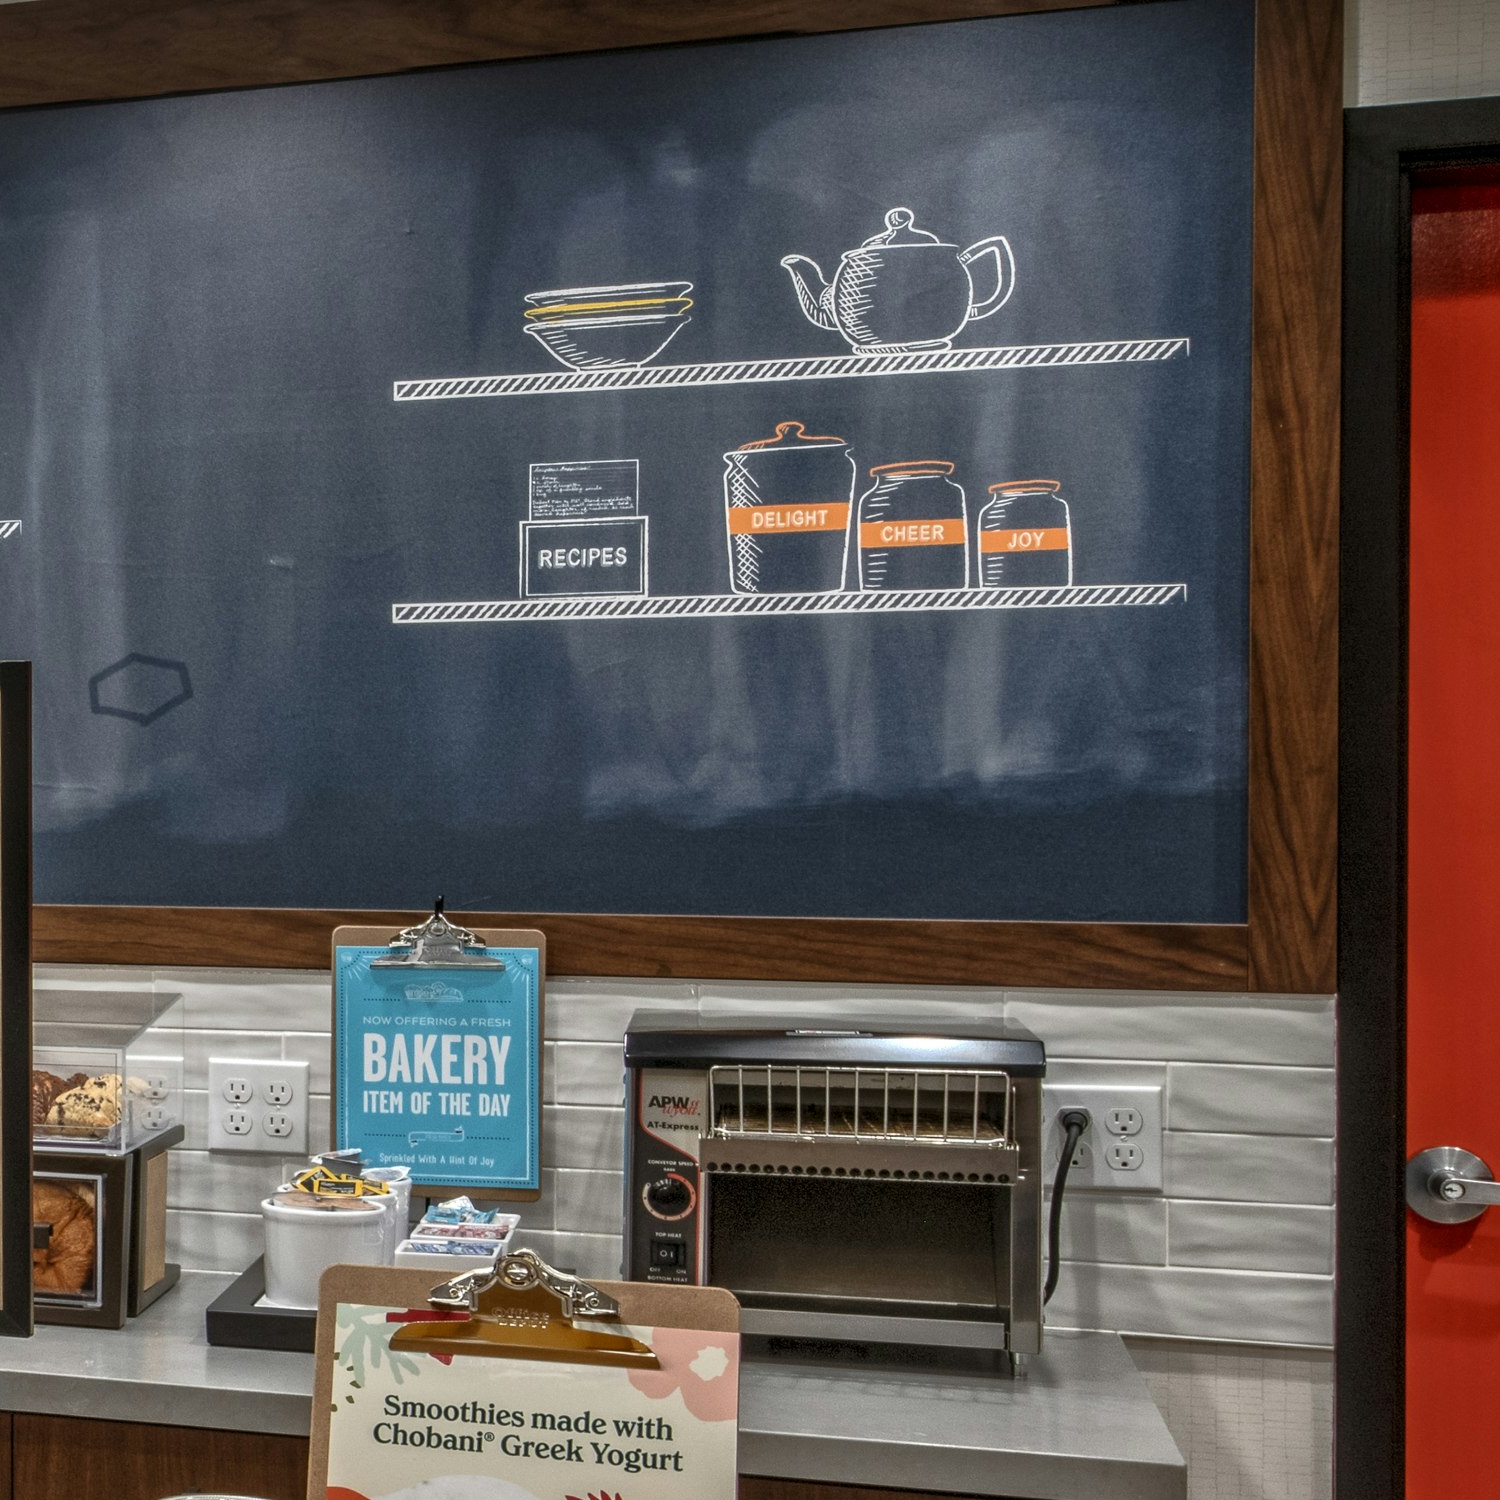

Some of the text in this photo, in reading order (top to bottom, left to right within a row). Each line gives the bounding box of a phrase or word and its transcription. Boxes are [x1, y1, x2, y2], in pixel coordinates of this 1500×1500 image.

[751, 509, 829, 530] DELIGHT
[880, 524, 945, 544] CHEER
[1006, 531, 1045, 550] JOY
[538, 547, 627, 569] RECIPES
[363, 1016, 511, 1028] NOW OFFERING A FRESH
[363, 1032, 512, 1086] BAKERY
[363, 1090, 511, 1118] ITEM OF THE DAY
[648, 1095, 690, 1109] APW
[646, 1121, 699, 1132] AT-Express
[379, 1152, 495, 1167] Sprinkled With A Hint Of Joy
[383, 1394, 674, 1441] Smoothies made with
[372, 1422, 684, 1474] Chobani® Greek Yogurt
